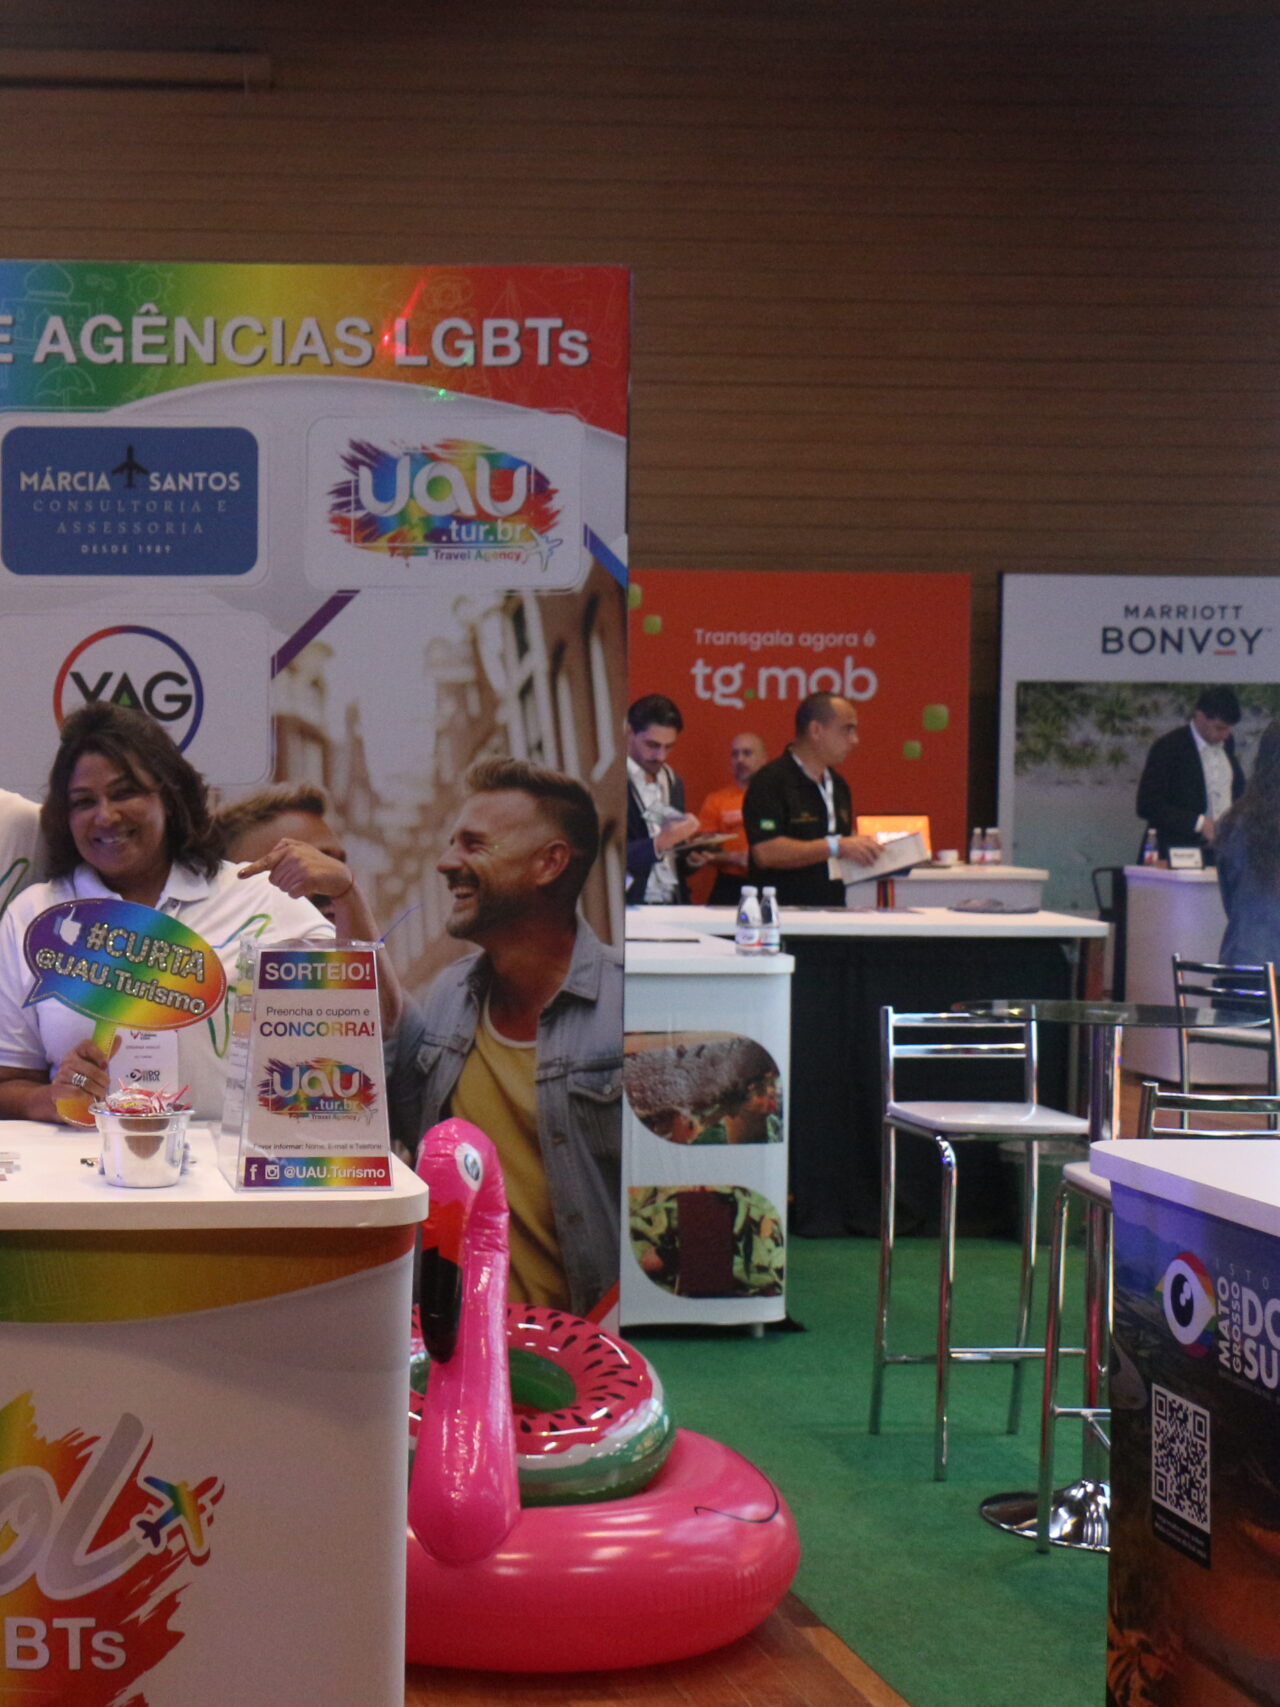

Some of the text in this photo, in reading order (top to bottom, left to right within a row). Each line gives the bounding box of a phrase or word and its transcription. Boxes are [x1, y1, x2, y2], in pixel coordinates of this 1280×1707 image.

[32, 303, 375, 366] AGÊNCIAS
[394, 316, 591, 368] LGBTs
[19, 467, 241, 492] MÁRCIA SANTOS
[32, 500, 227, 513] CONSULTORIA E
[55, 522, 204, 534] ASSESSORIA
[440, 519, 527, 542] .tur.br
[80, 545, 129, 555] DESDE
[432, 550, 522, 563] Travel Agency
[1124, 604, 1244, 620] MARRIOTT
[798, 632, 859, 652] agora
[1101, 626, 1264, 656] BONVOY
[690, 655, 879, 709] tg.mob
[86, 922, 206, 983] #CURTA
[35, 947, 207, 1015] @UAU.Turismo
[265, 962, 371, 981] SORTEIO!
[266, 1006, 371, 1018] Preencha o cupom e
[260, 1021, 376, 1037] CONCORRA!
[284, 1165, 386, 1180] @UAU.Turismo
[1217, 1276, 1231, 1369] MATO
[1230, 1281, 1242, 1374] GROSSO
